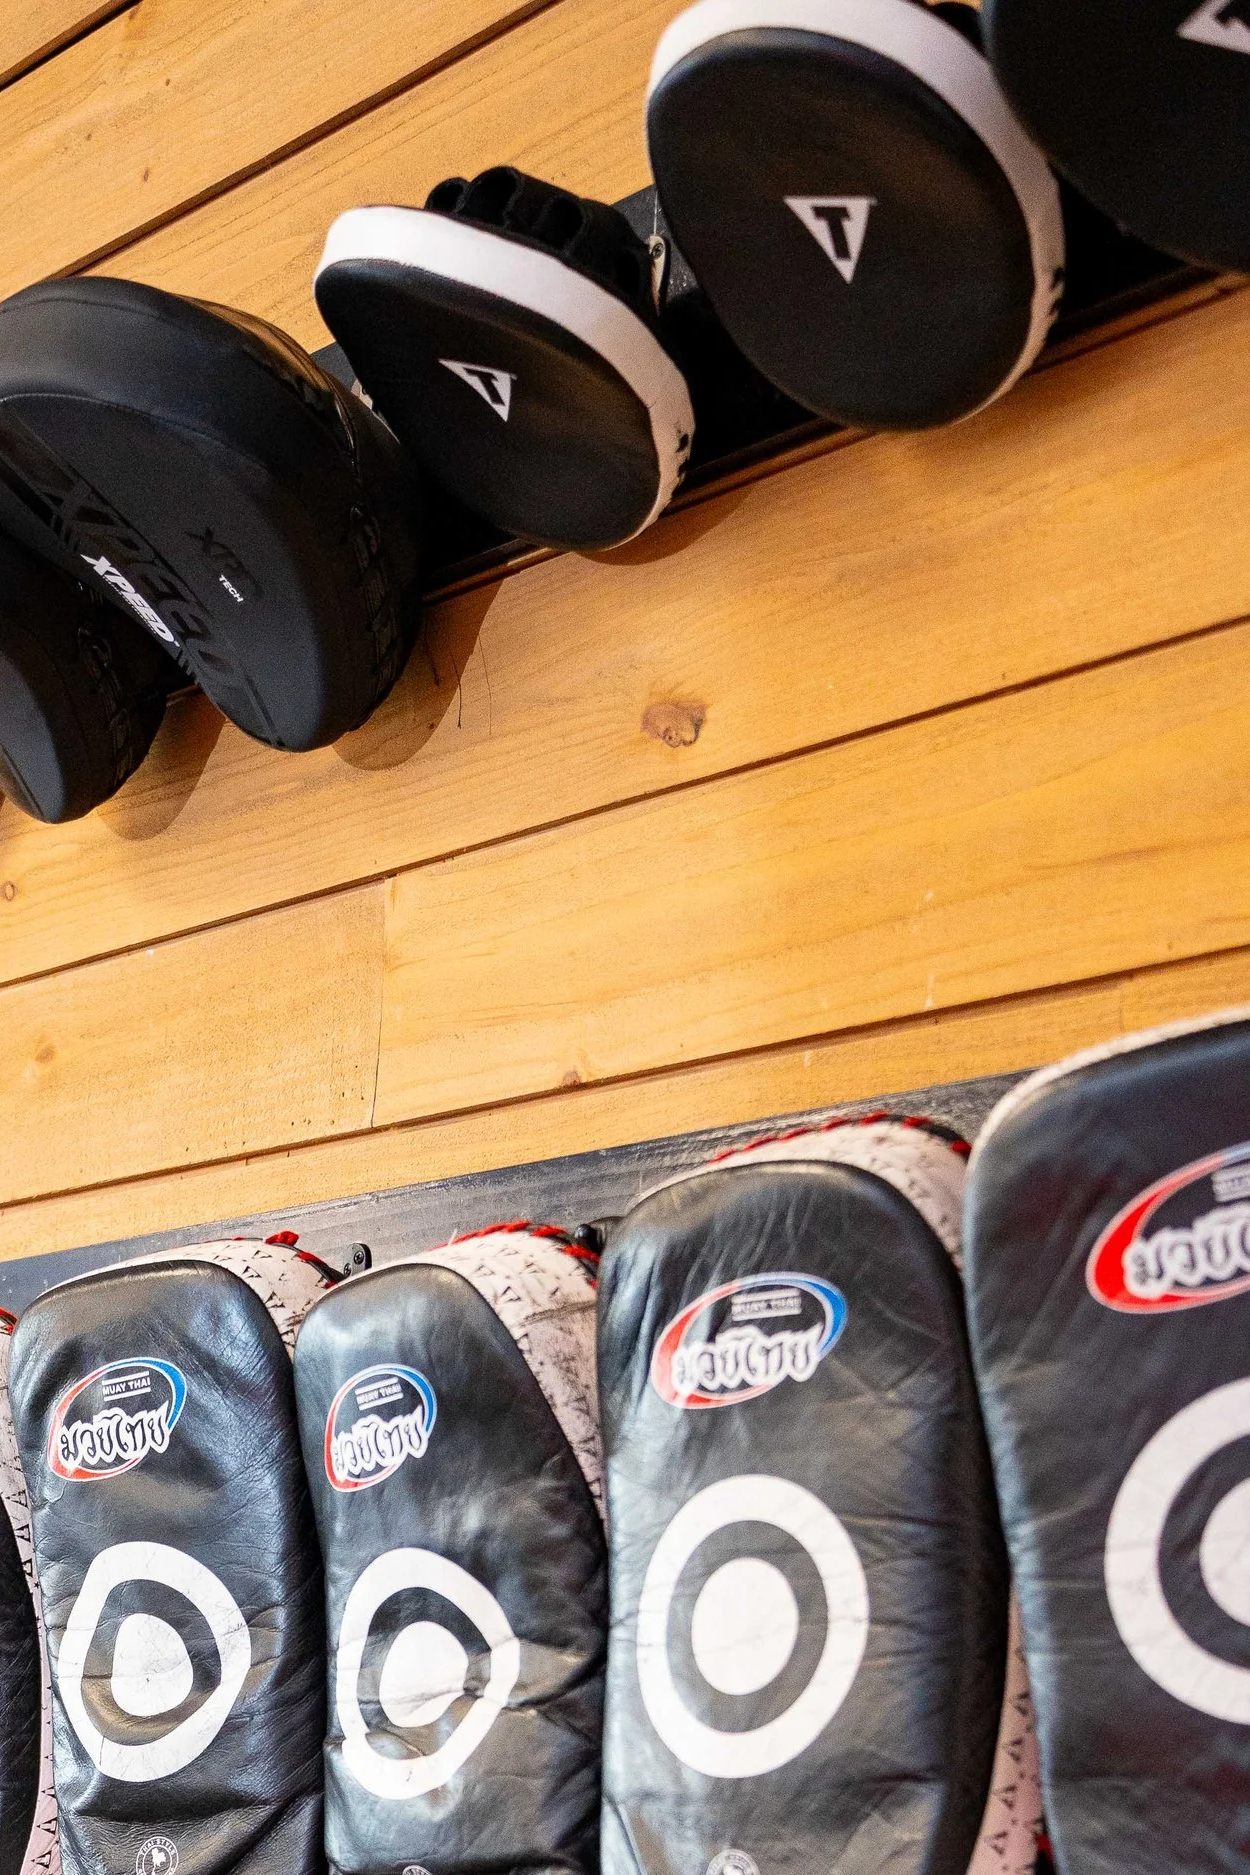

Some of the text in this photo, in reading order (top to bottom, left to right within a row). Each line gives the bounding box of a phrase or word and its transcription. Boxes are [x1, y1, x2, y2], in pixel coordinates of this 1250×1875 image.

[79, 553, 180, 647] XPEED
[217, 574, 244, 603] TECH
[102, 1376, 151, 1396] MUAY THAI
